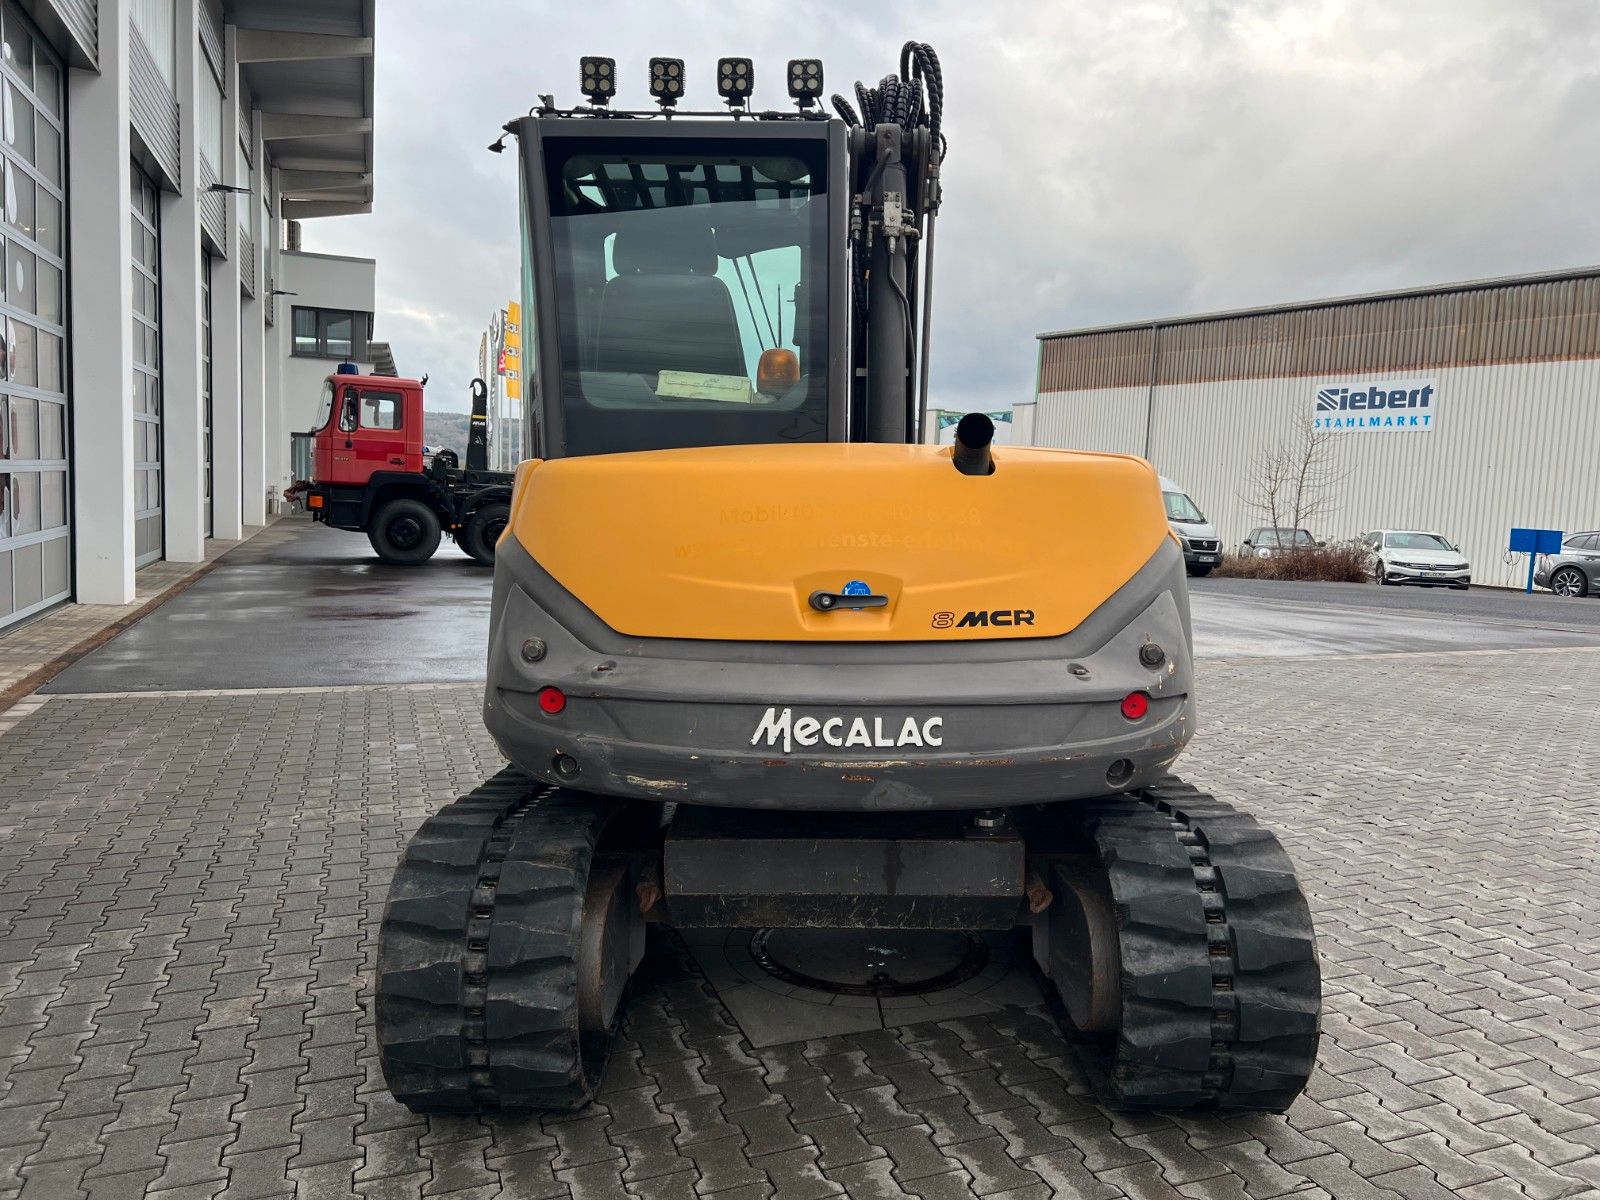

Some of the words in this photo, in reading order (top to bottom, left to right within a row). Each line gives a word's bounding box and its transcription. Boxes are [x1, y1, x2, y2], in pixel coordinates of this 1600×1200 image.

[1317, 384, 1434, 411] Siebert
[1315, 415, 1431, 428] STAHLMARKT
[931, 611, 955, 629] 8
[955, 609, 1036, 628] MCR
